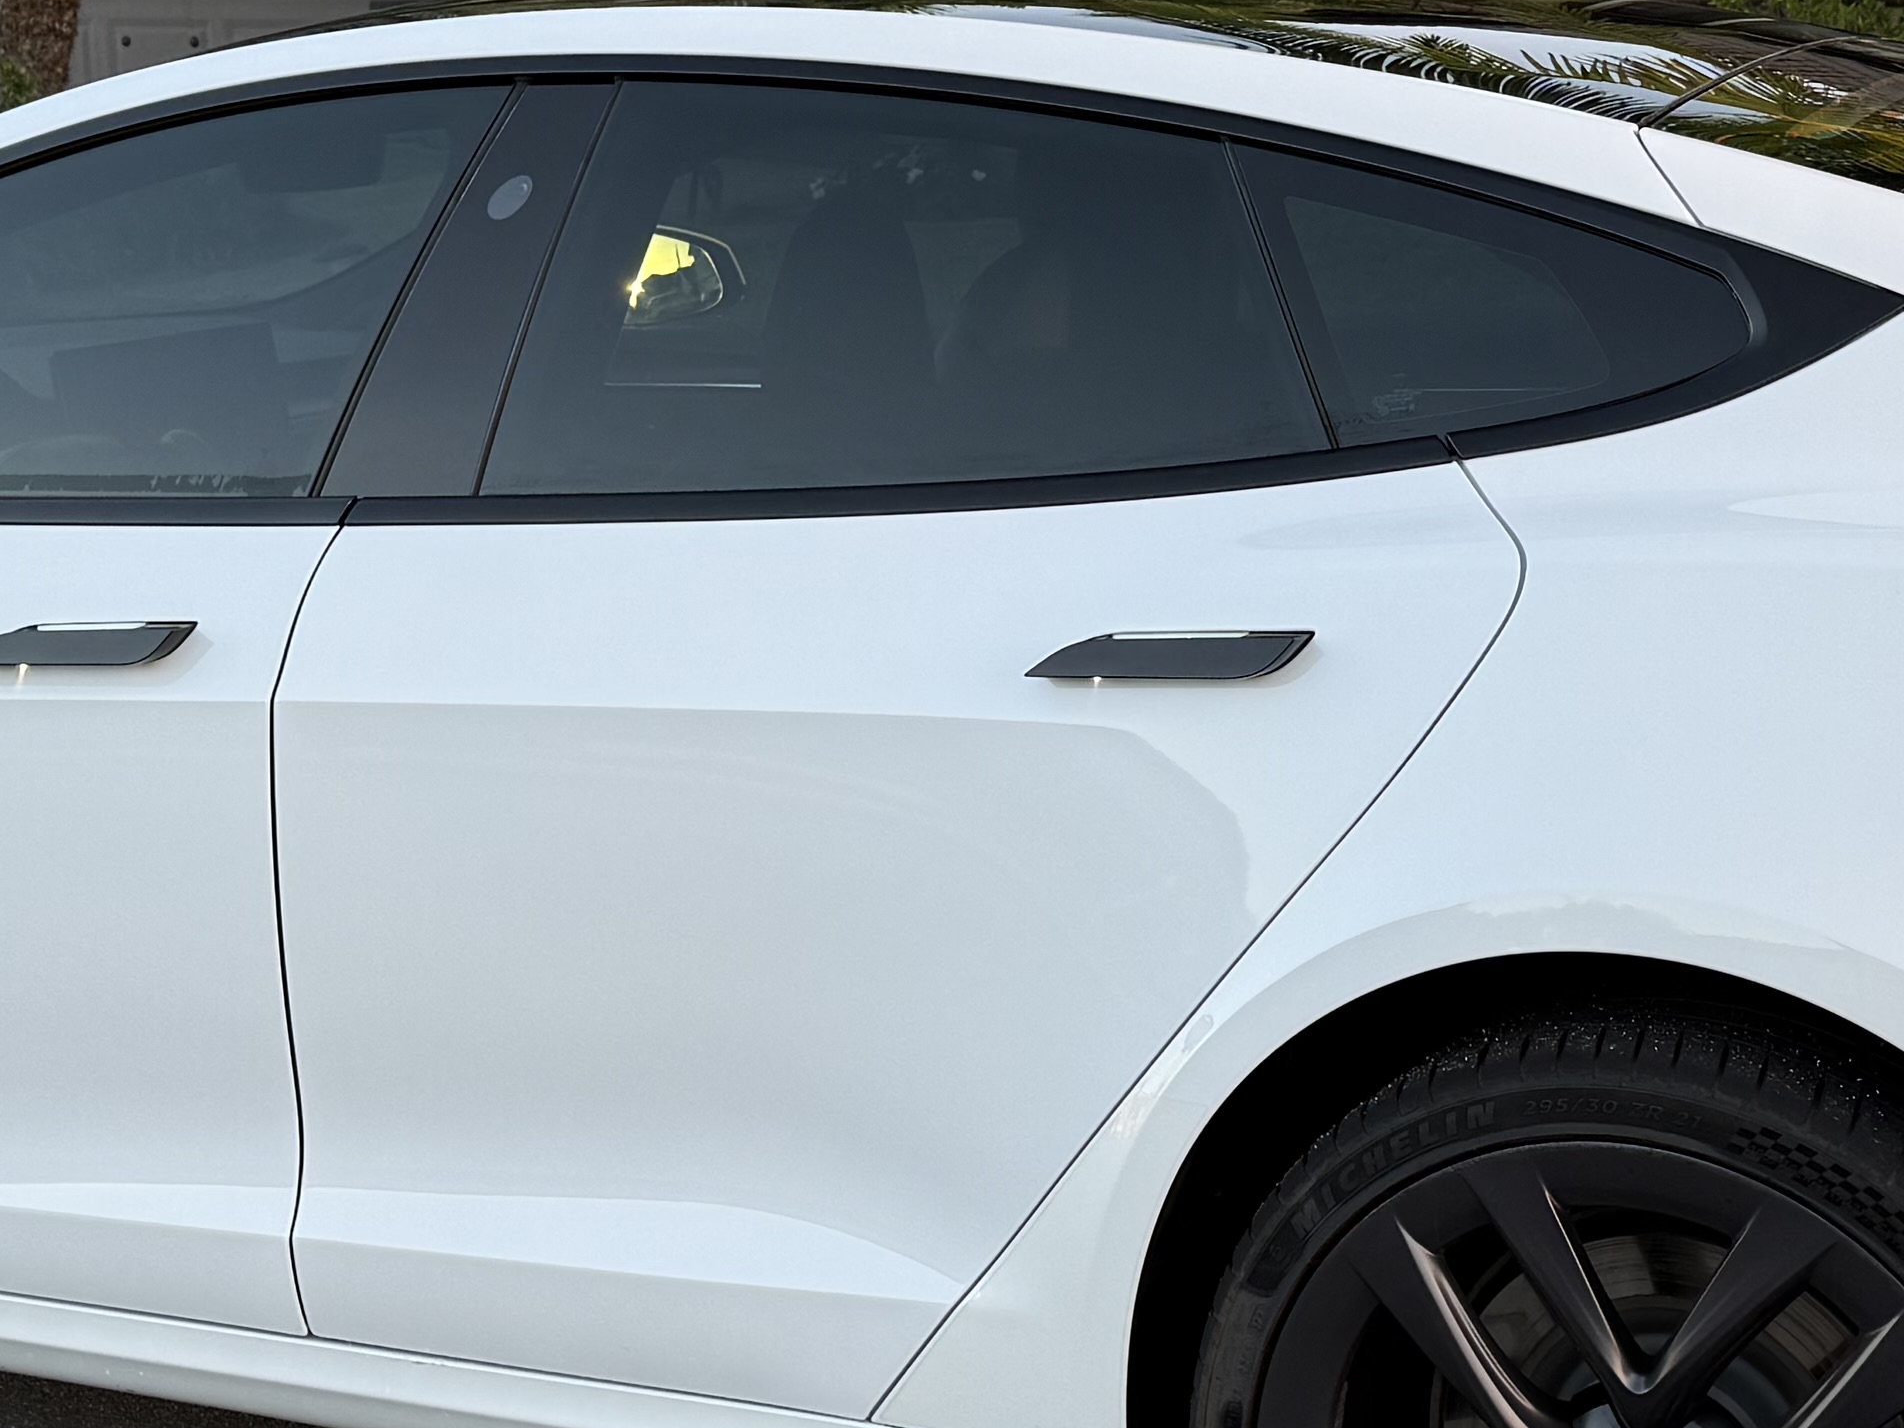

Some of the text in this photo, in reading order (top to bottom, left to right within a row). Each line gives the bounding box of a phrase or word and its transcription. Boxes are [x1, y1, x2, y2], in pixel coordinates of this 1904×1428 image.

[1291, 1097, 1704, 1240] MICHELIN 295/30 ZR 21
